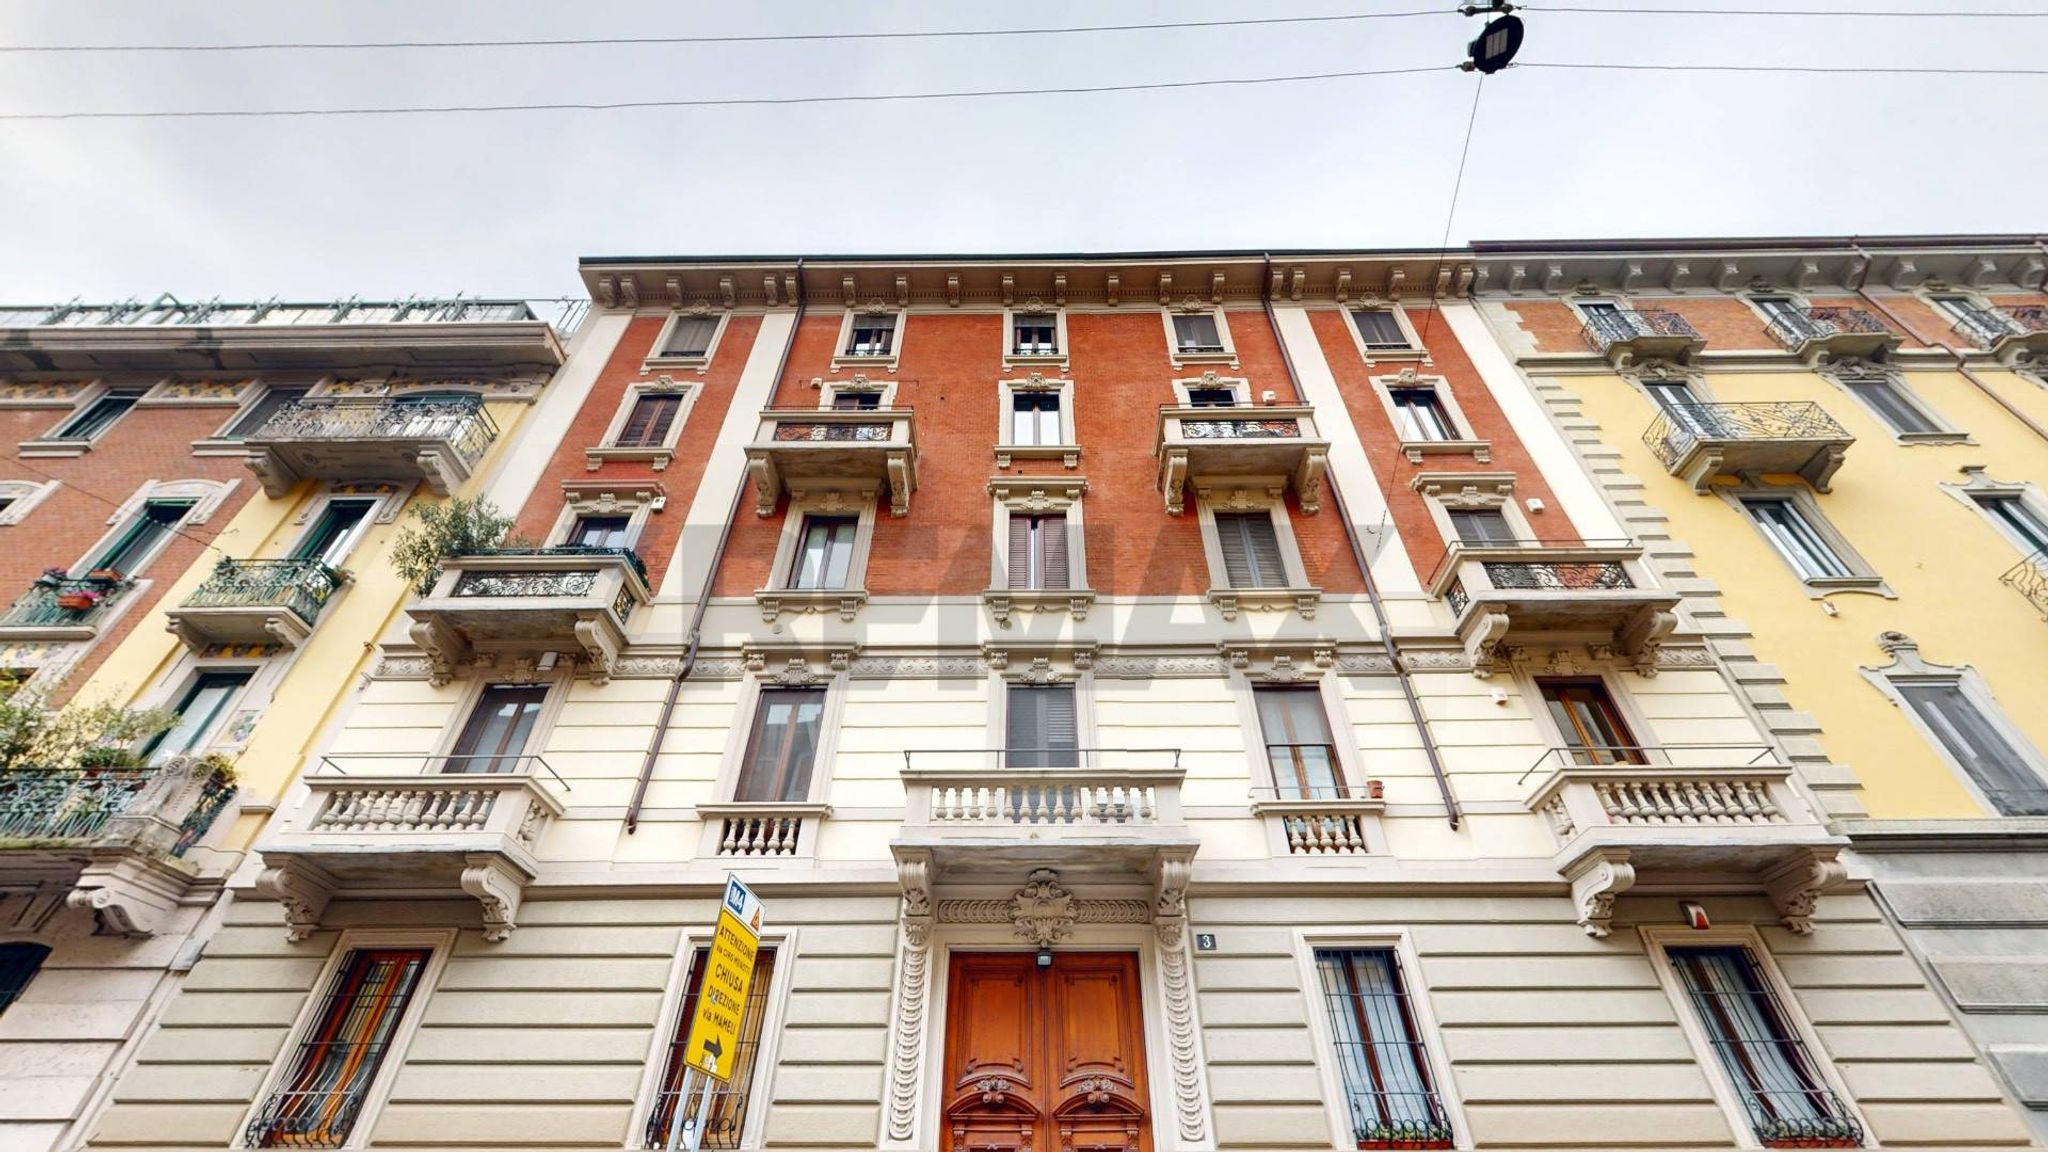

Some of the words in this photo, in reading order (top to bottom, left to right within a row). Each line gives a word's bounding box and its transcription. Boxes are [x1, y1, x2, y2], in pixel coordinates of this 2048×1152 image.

[719, 925, 755, 962] ATTENZIONE
[1203, 935, 1211, 948] 3
[715, 963, 743, 994] CHIUSA
[713, 1011, 736, 1035] MAMELI
